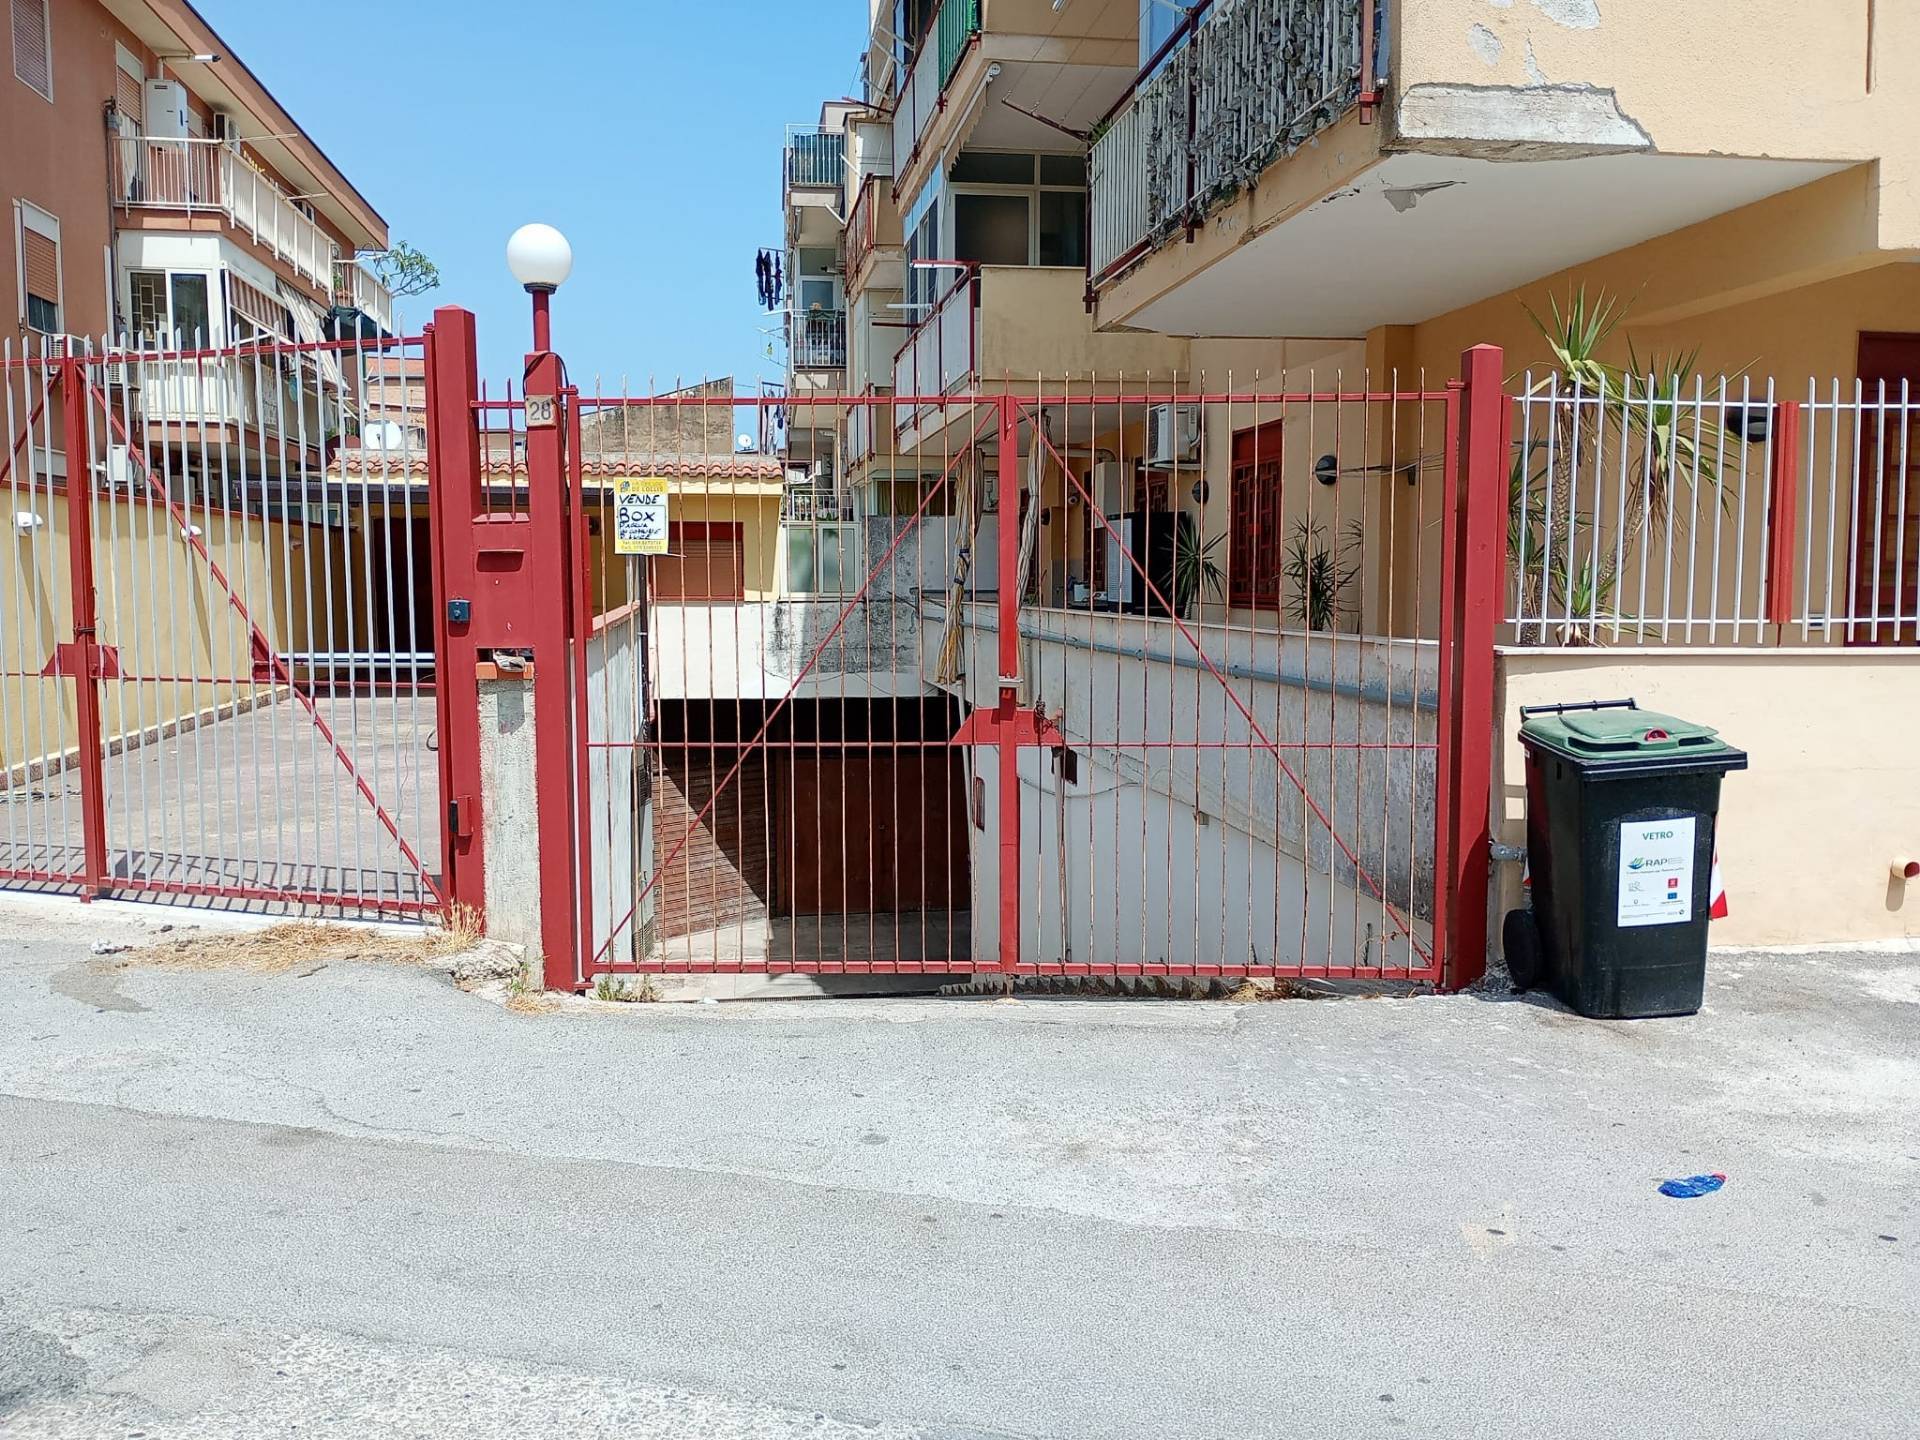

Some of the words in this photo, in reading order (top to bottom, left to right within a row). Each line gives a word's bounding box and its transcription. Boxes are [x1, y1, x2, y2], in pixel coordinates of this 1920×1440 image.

[530, 401, 551, 420] 28
[619, 494, 660, 505] VENDE
[619, 507, 655, 523] BOX
[1642, 831, 1674, 840] VETRO
[1645, 858, 1668, 867] RAP
